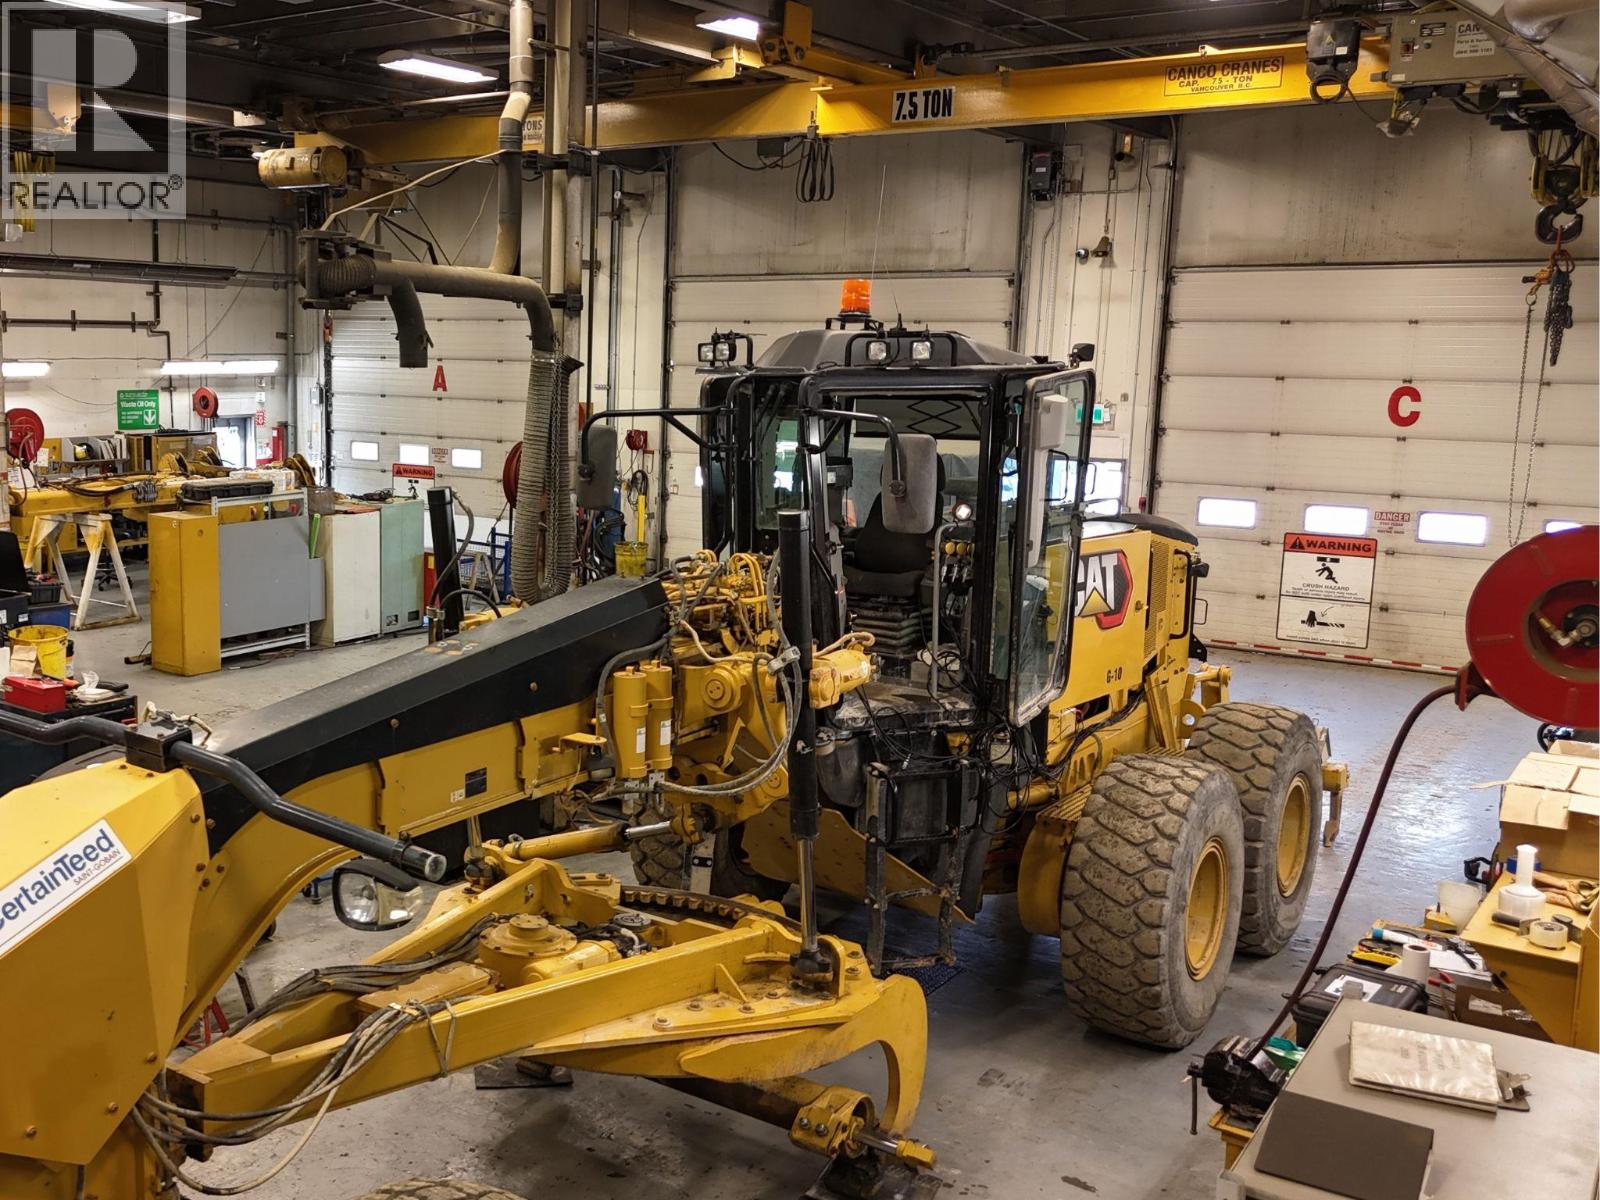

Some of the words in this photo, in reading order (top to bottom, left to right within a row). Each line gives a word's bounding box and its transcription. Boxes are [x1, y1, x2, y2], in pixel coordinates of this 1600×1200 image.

[1167, 64, 1217, 81] CANCO
[1220, 58, 1281, 77] CRANES
[1178, 80, 1200, 88] CAP.
[1232, 75, 1253, 83] TON
[1190, 84, 1234, 93] VANCOUVER
[895, 91, 918, 121] 7.5
[922, 88, 953, 118] TON
[432, 365, 448, 392] A
[1387, 385, 1422, 428] C
[402, 467, 433, 477] WARNING
[1375, 512, 1410, 522] DANGER
[1306, 539, 1372, 553] WARNING
[73, 848, 121, 886] SAINT-GOBAIN
[0, 828, 115, 931] ertainTeed
